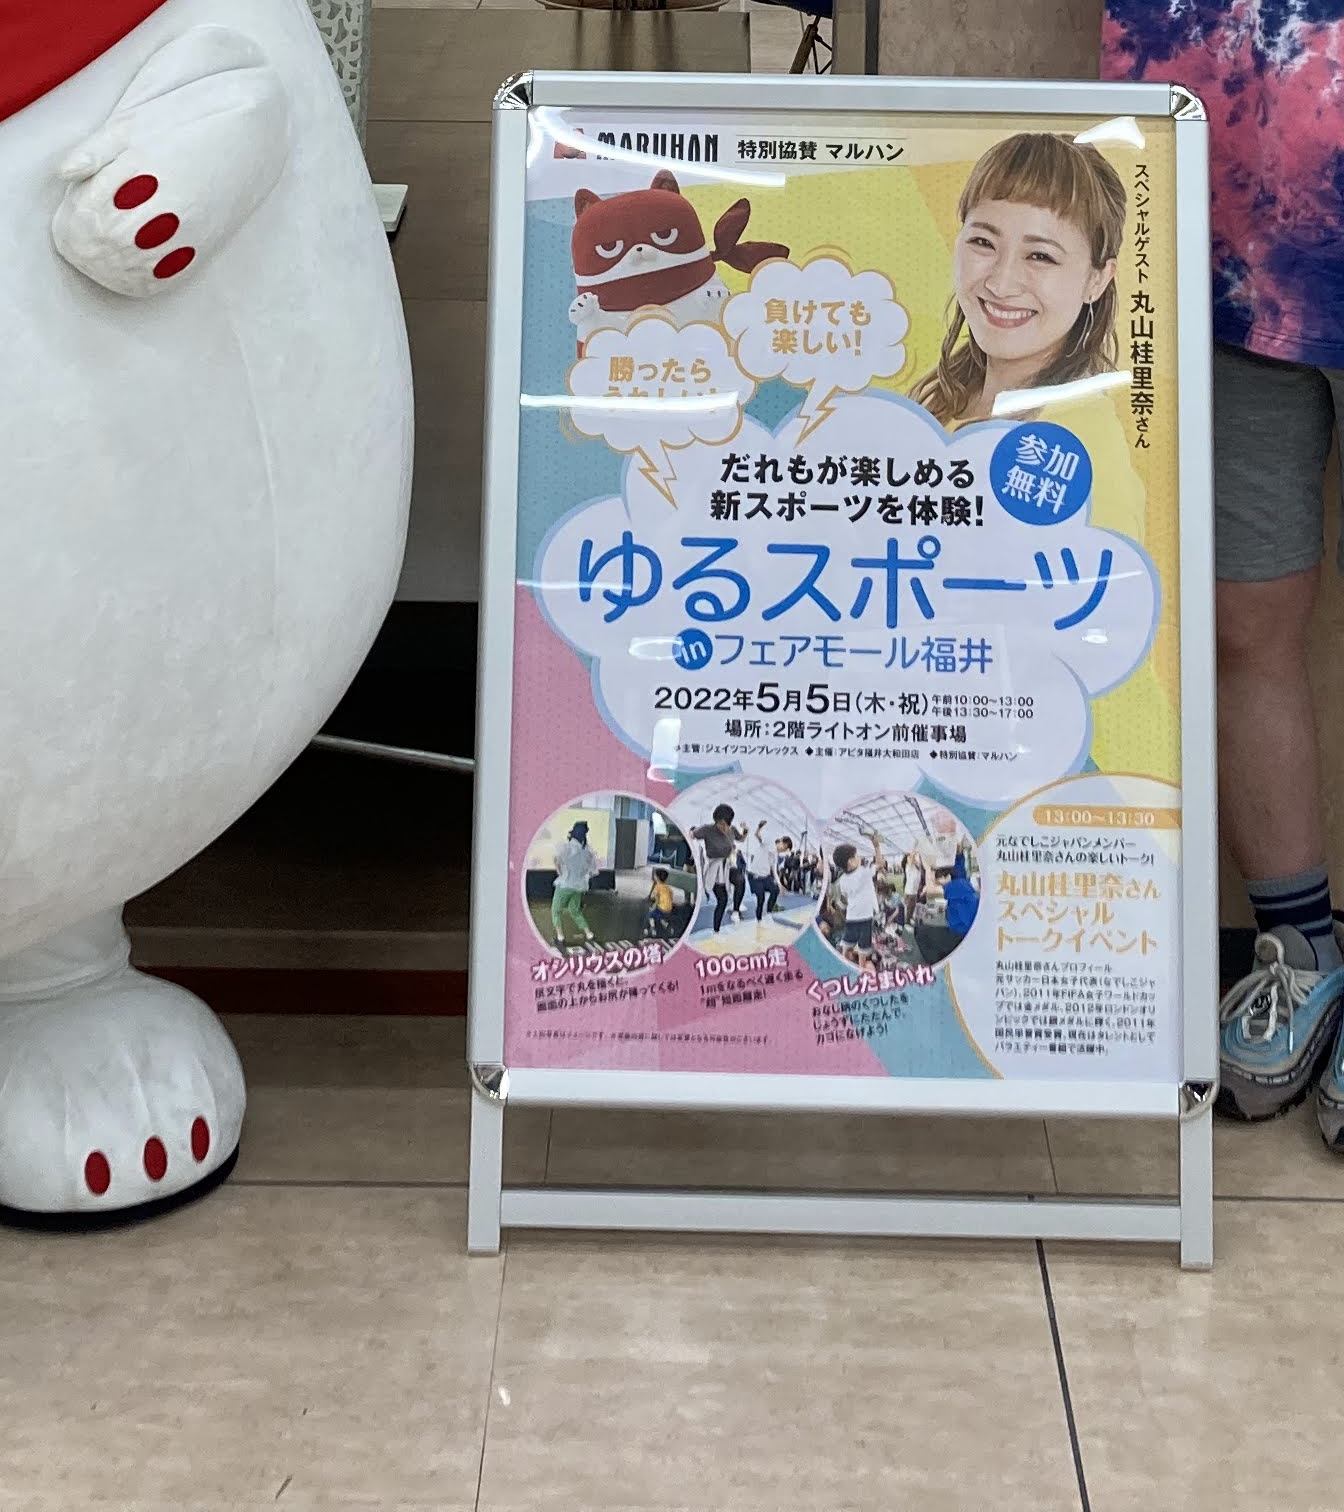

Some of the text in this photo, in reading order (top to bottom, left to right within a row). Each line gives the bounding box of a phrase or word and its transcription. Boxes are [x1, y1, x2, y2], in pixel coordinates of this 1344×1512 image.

[737, 140, 905, 162] 特別協賛 マルハン
[763, 298, 873, 326] 負けても
[1129, 163, 1155, 449] スペシャルゲスト 丸山桂里奈さん
[771, 328, 863, 357] 楽しい!
[608, 356, 711, 383] 勝ったら
[720, 452, 976, 489] だれもが楽しめる
[1014, 433, 1080, 482] 参加
[1003, 465, 1069, 515] 無料
[709, 490, 985, 527] 新スポーツを体験!
[578, 534, 1114, 631] ゆるスポーツ
[680, 632, 707, 666] in
[714, 634, 994, 675] フェアモール福井
[654, 682, 928, 716] 2022年5月5日(木・祝)
[725, 719, 967, 743] 場所:2階ライトオン前催事場
[996, 870, 1161, 900] 丸山桂里奈さん
[998, 899, 1115, 925] スペシャル
[997, 925, 1158, 955] トークイベント
[694, 945, 788, 979] 100cm走
[806, 963, 937, 1002] くつしたまいれ
